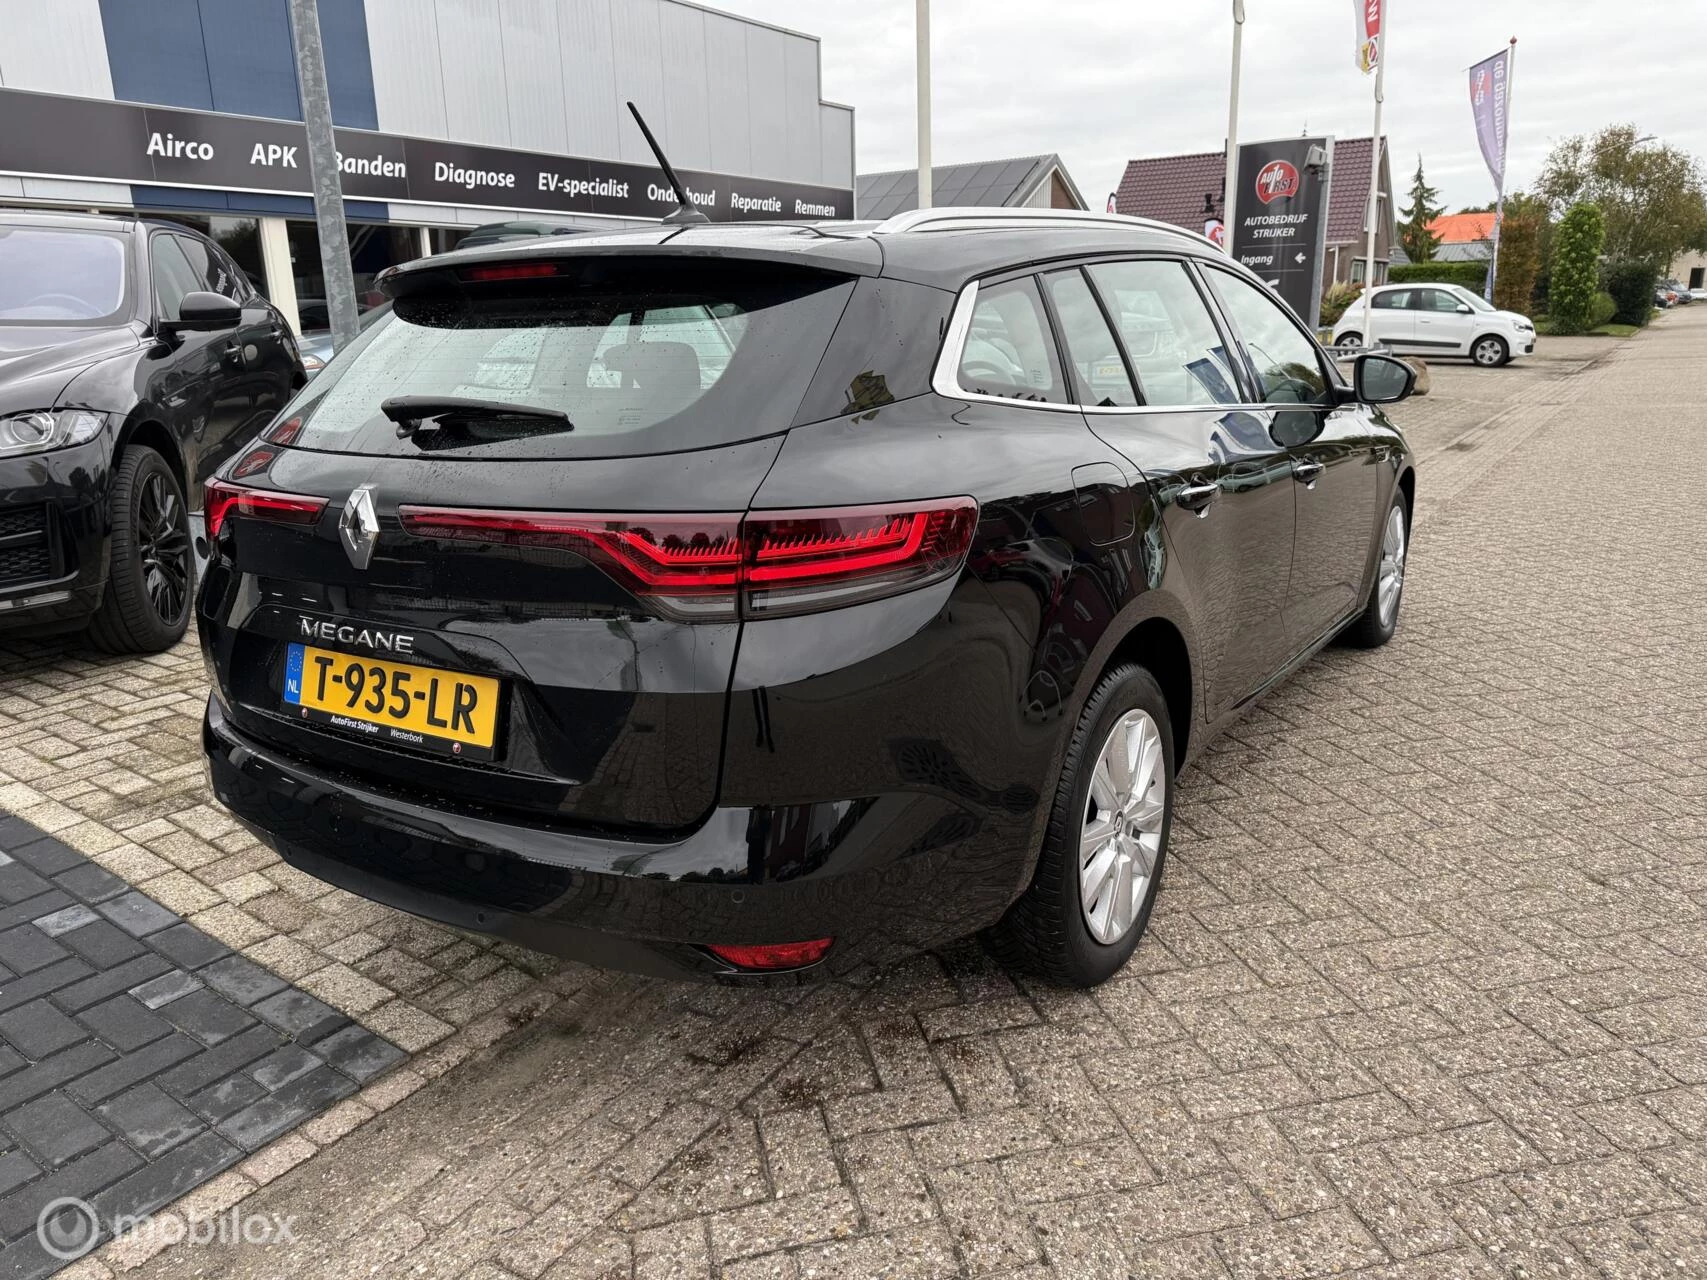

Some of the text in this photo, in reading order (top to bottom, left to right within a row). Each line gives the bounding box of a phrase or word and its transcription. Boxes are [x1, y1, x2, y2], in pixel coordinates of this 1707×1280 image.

[146, 133, 214, 160] Airco
[250, 144, 298, 169] APK
[434, 162, 516, 190] Diagnose
[538, 172, 629, 199] EV-specialist
[730, 193, 782, 214] Reparatie
[795, 199, 836, 217] Remmen
[1244, 213, 1308, 226] AUTOBEDRIJF
[1252, 228, 1295, 239] STRIJKER
[1241, 255, 1273, 266] Ingang
[300, 616, 415, 654] MEGANE
[287, 678, 299, 694] NL
[314, 656, 478, 734] T-935-LR
[330, 715, 379, 733] AutoFirst Strijker
[390, 728, 423, 743] Westerbork
